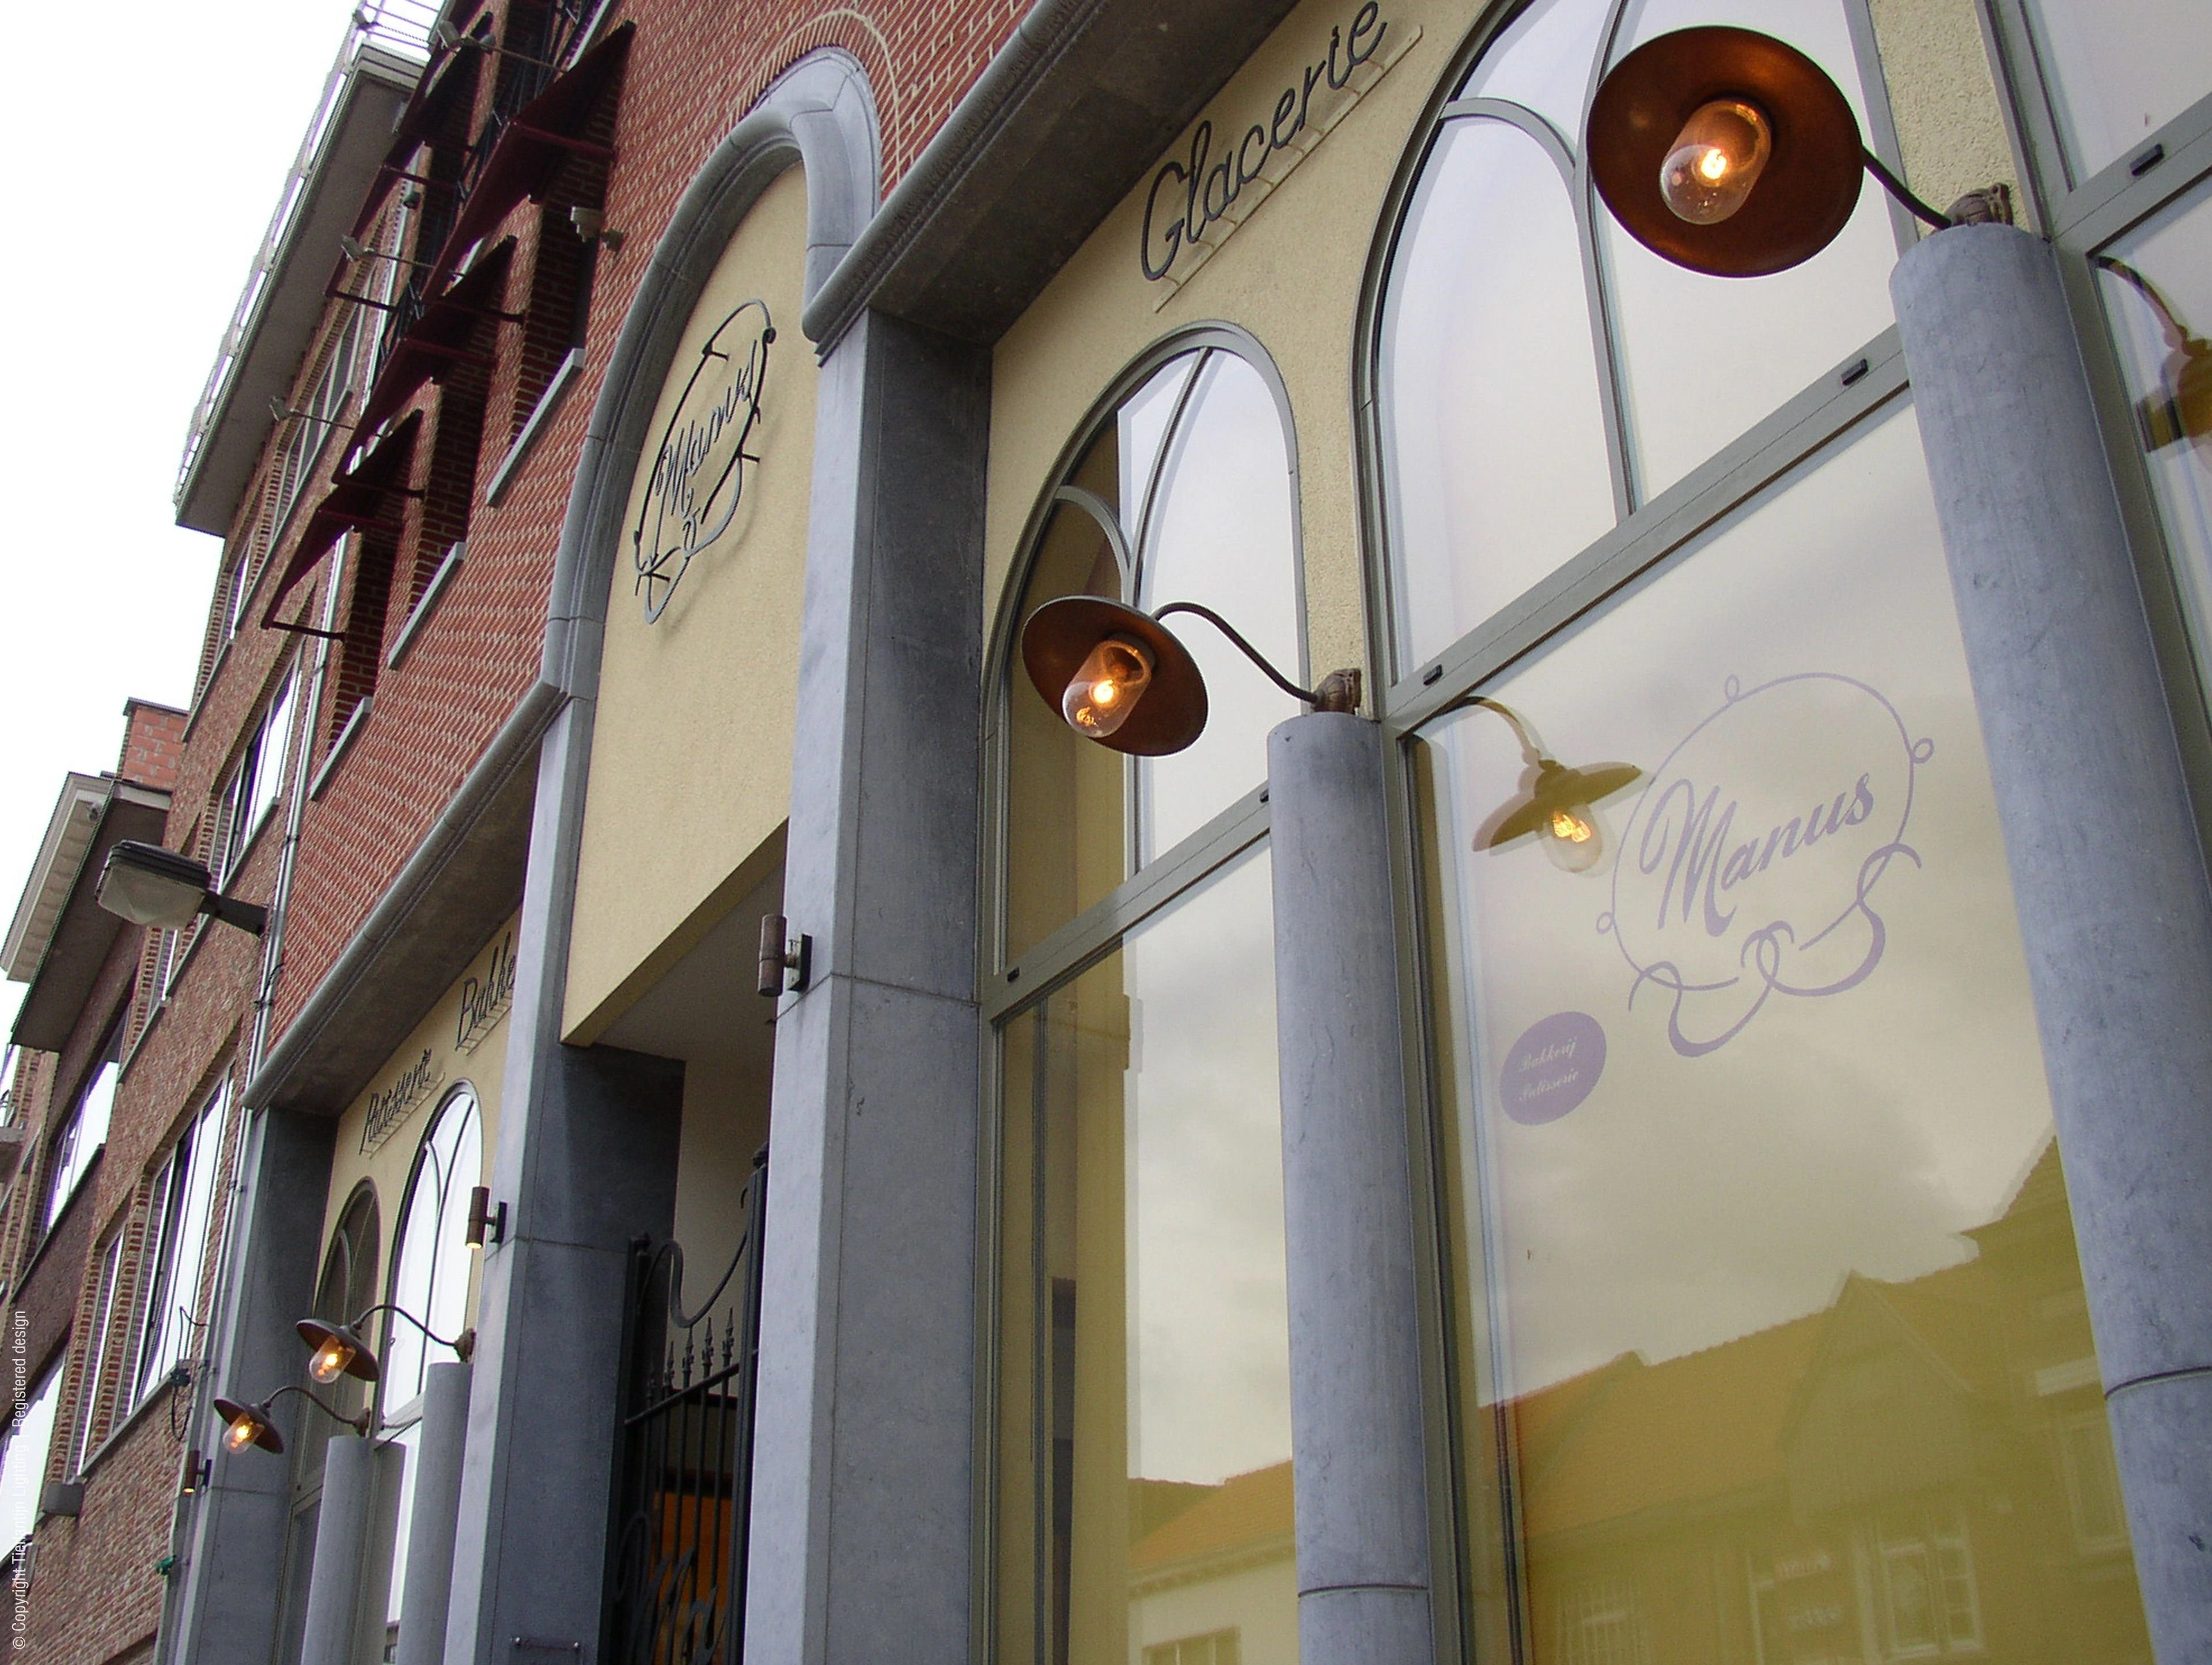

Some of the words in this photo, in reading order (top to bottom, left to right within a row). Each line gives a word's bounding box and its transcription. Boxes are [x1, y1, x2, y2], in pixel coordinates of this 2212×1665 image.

[1141, 1, 1388, 281] Glacerie
[1638, 772, 1875, 937] Manus
[454, 930, 516, 1051] Bakke
